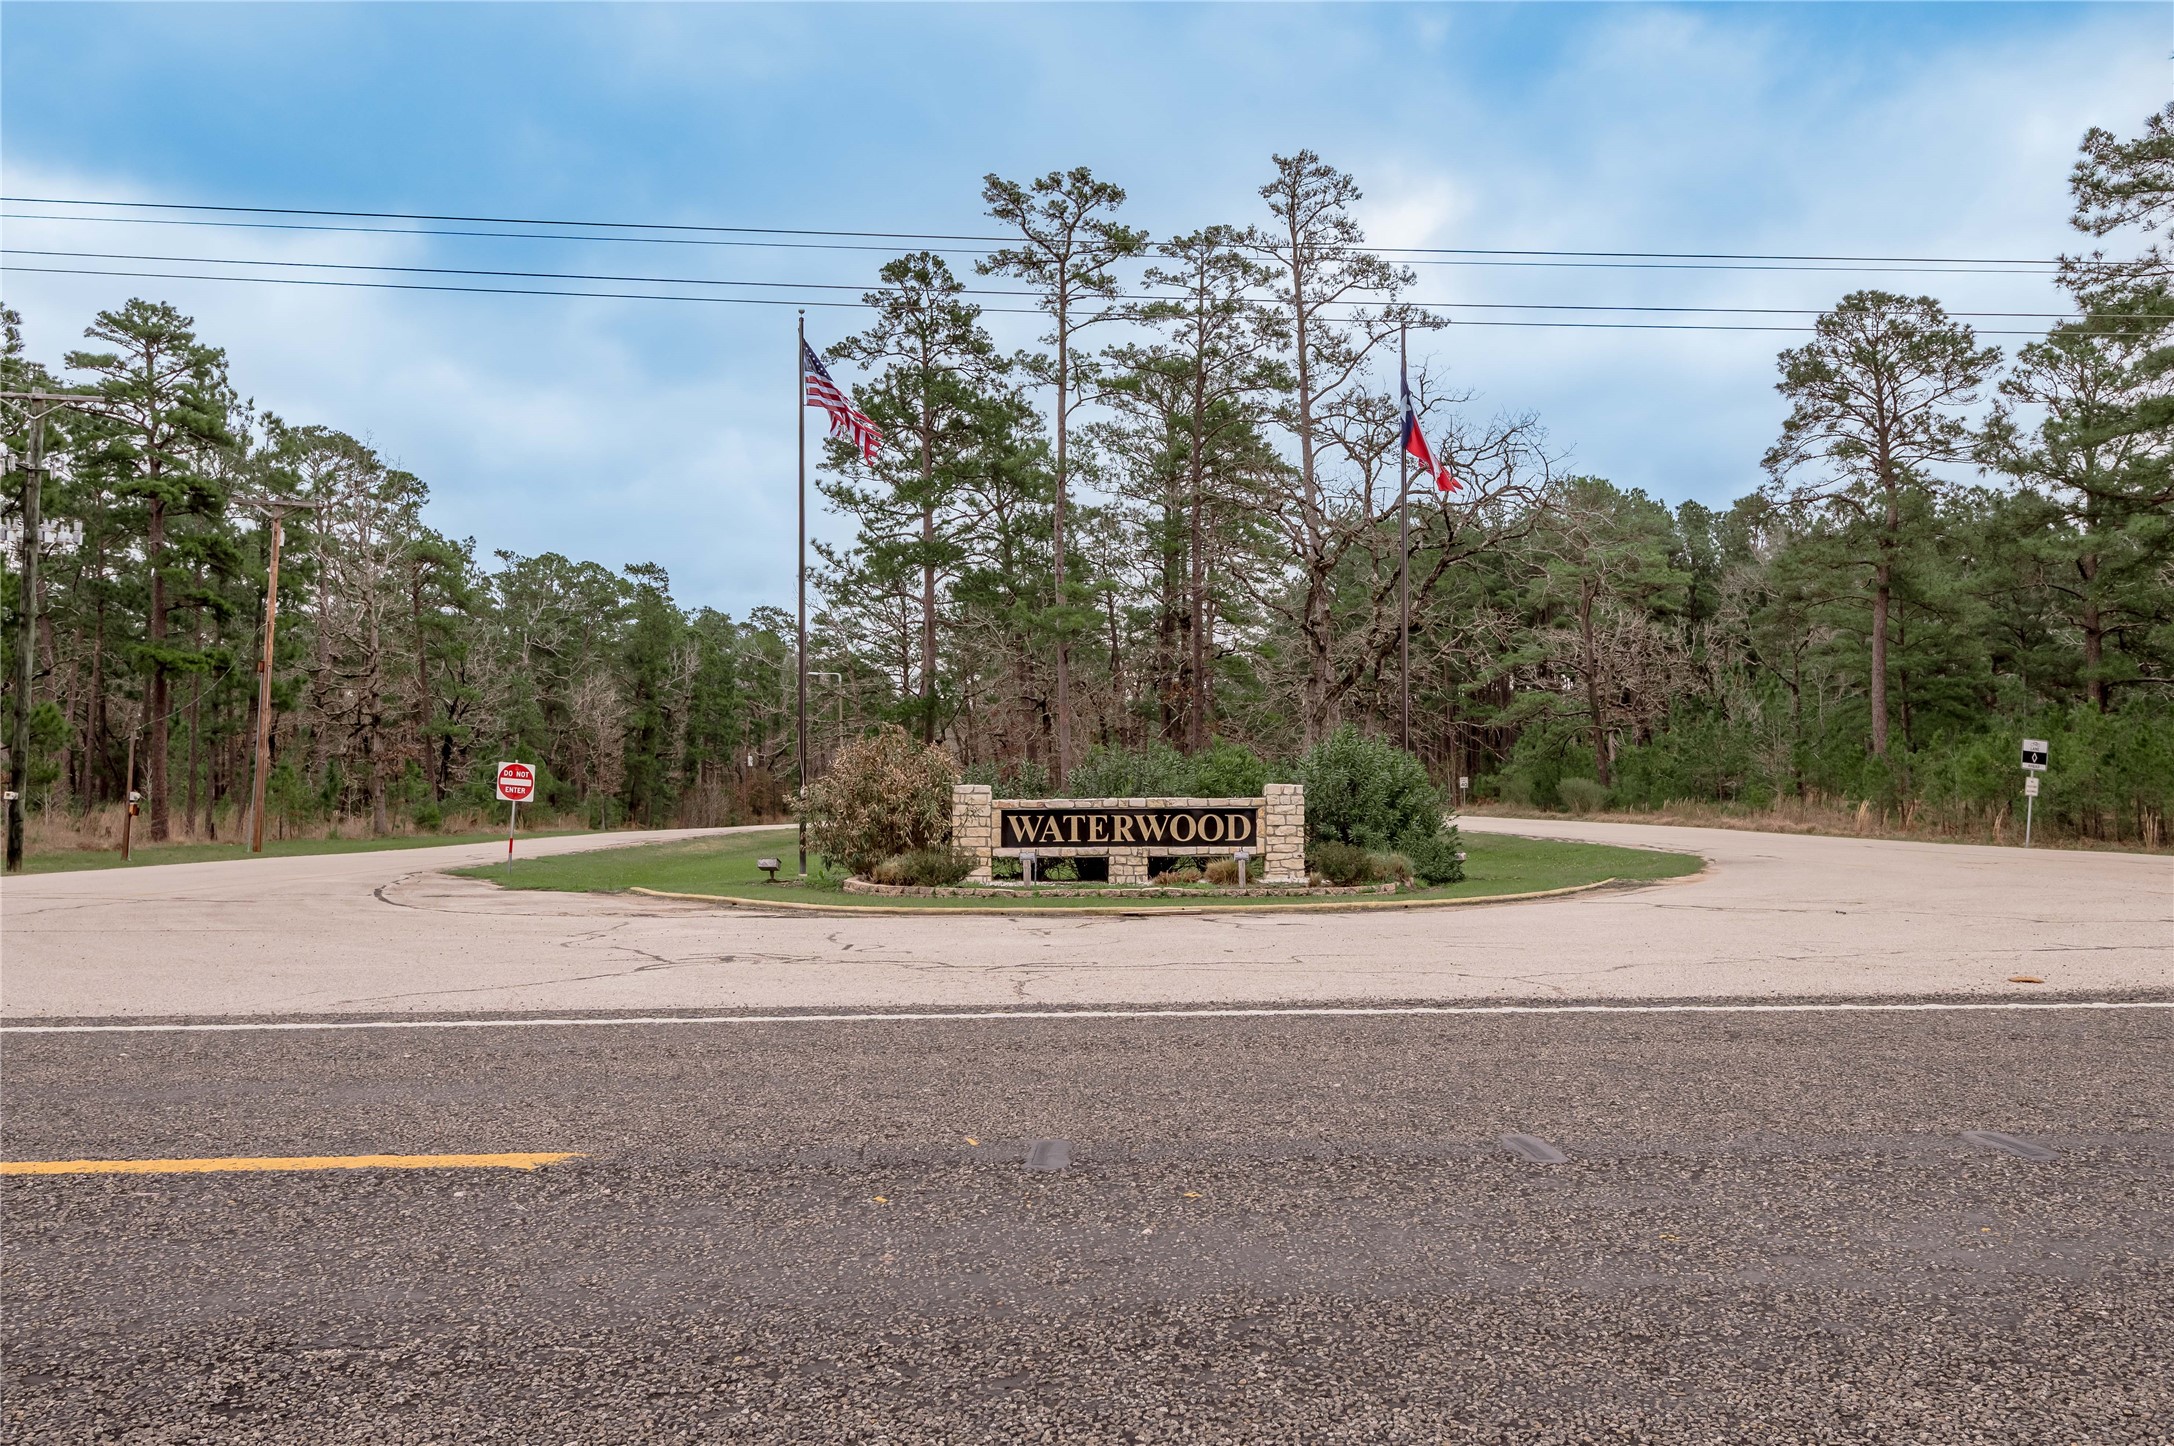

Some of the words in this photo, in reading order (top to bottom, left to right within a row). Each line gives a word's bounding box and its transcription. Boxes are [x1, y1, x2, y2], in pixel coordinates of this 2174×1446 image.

[503, 769, 513, 777] DO
[505, 786, 526, 794] ENTER
[1006, 814, 1252, 843] WATERWOOD
